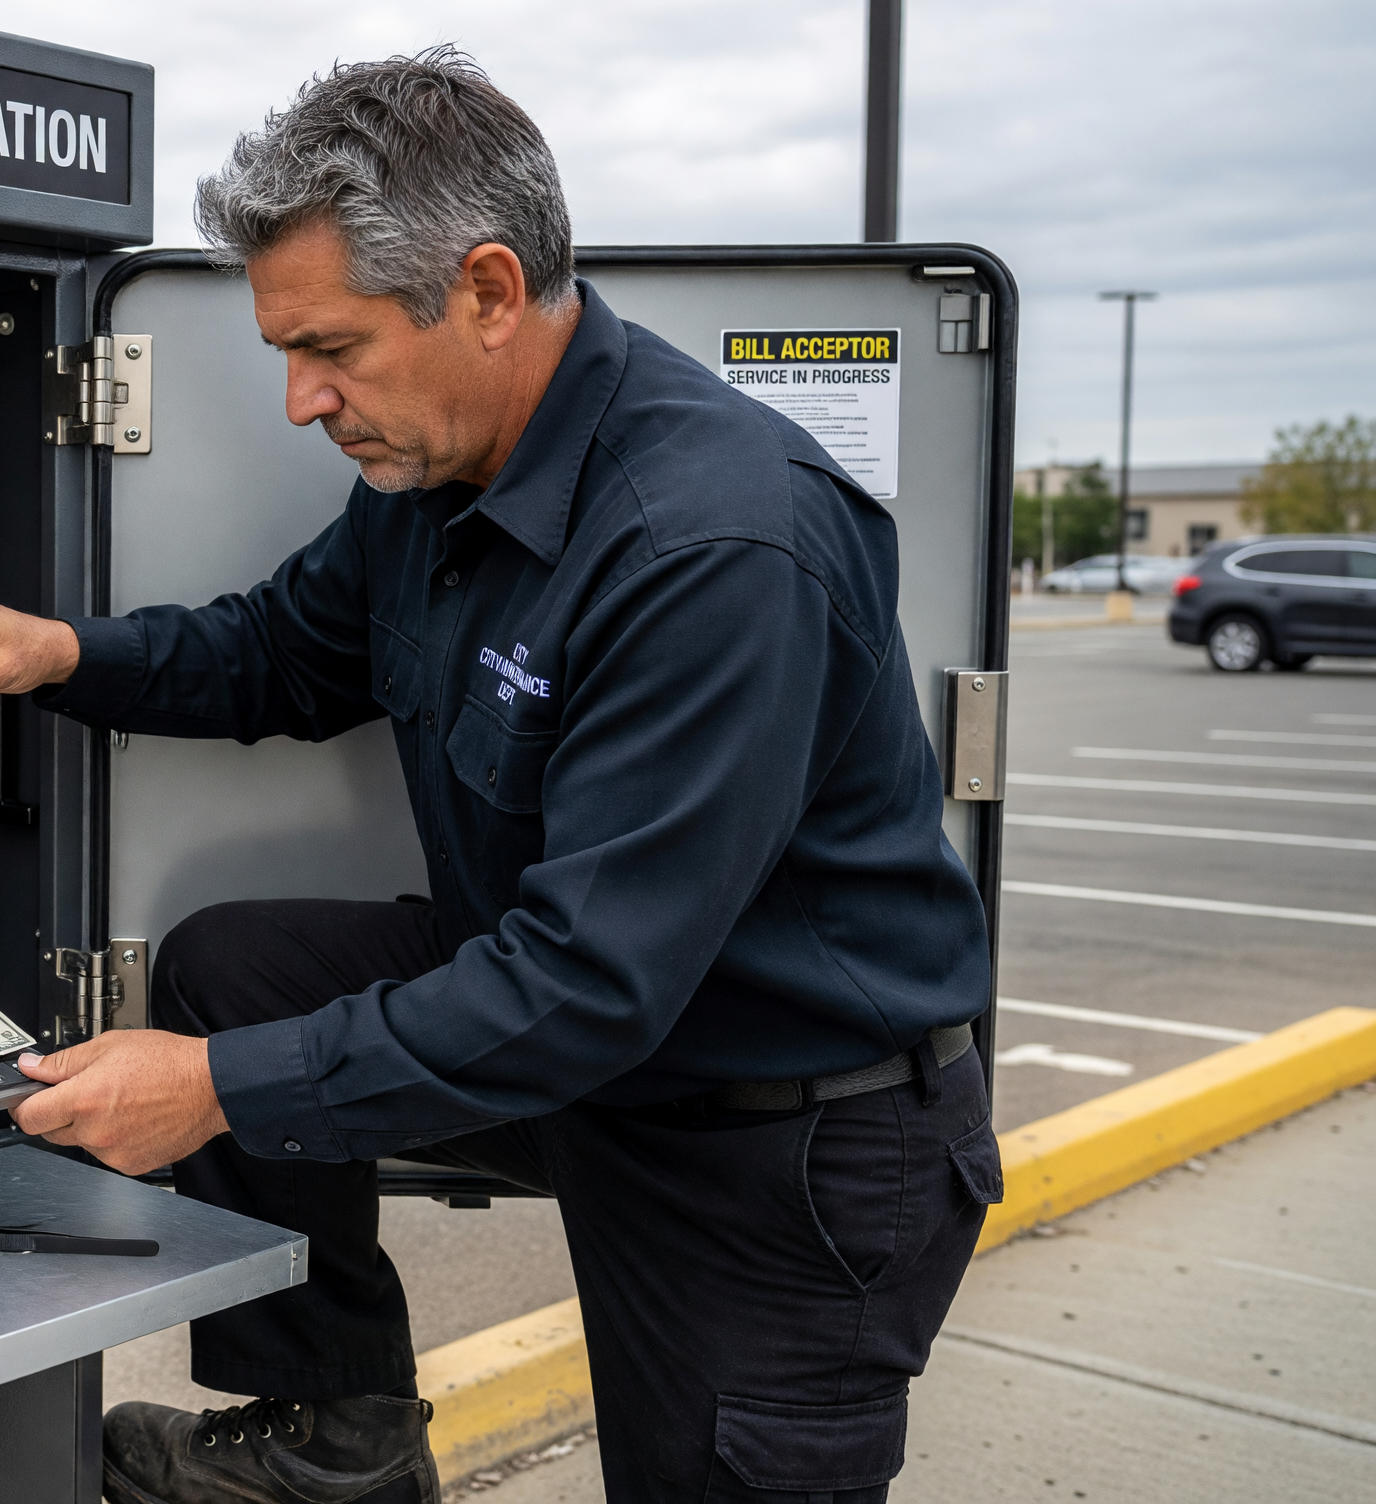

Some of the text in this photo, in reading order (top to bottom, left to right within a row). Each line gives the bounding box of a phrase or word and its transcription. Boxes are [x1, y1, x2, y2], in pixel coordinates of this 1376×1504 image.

[731, 336, 891, 360] BILL ACCEPTOR
[727, 368, 891, 385] SERVICE IN PROGRESS
